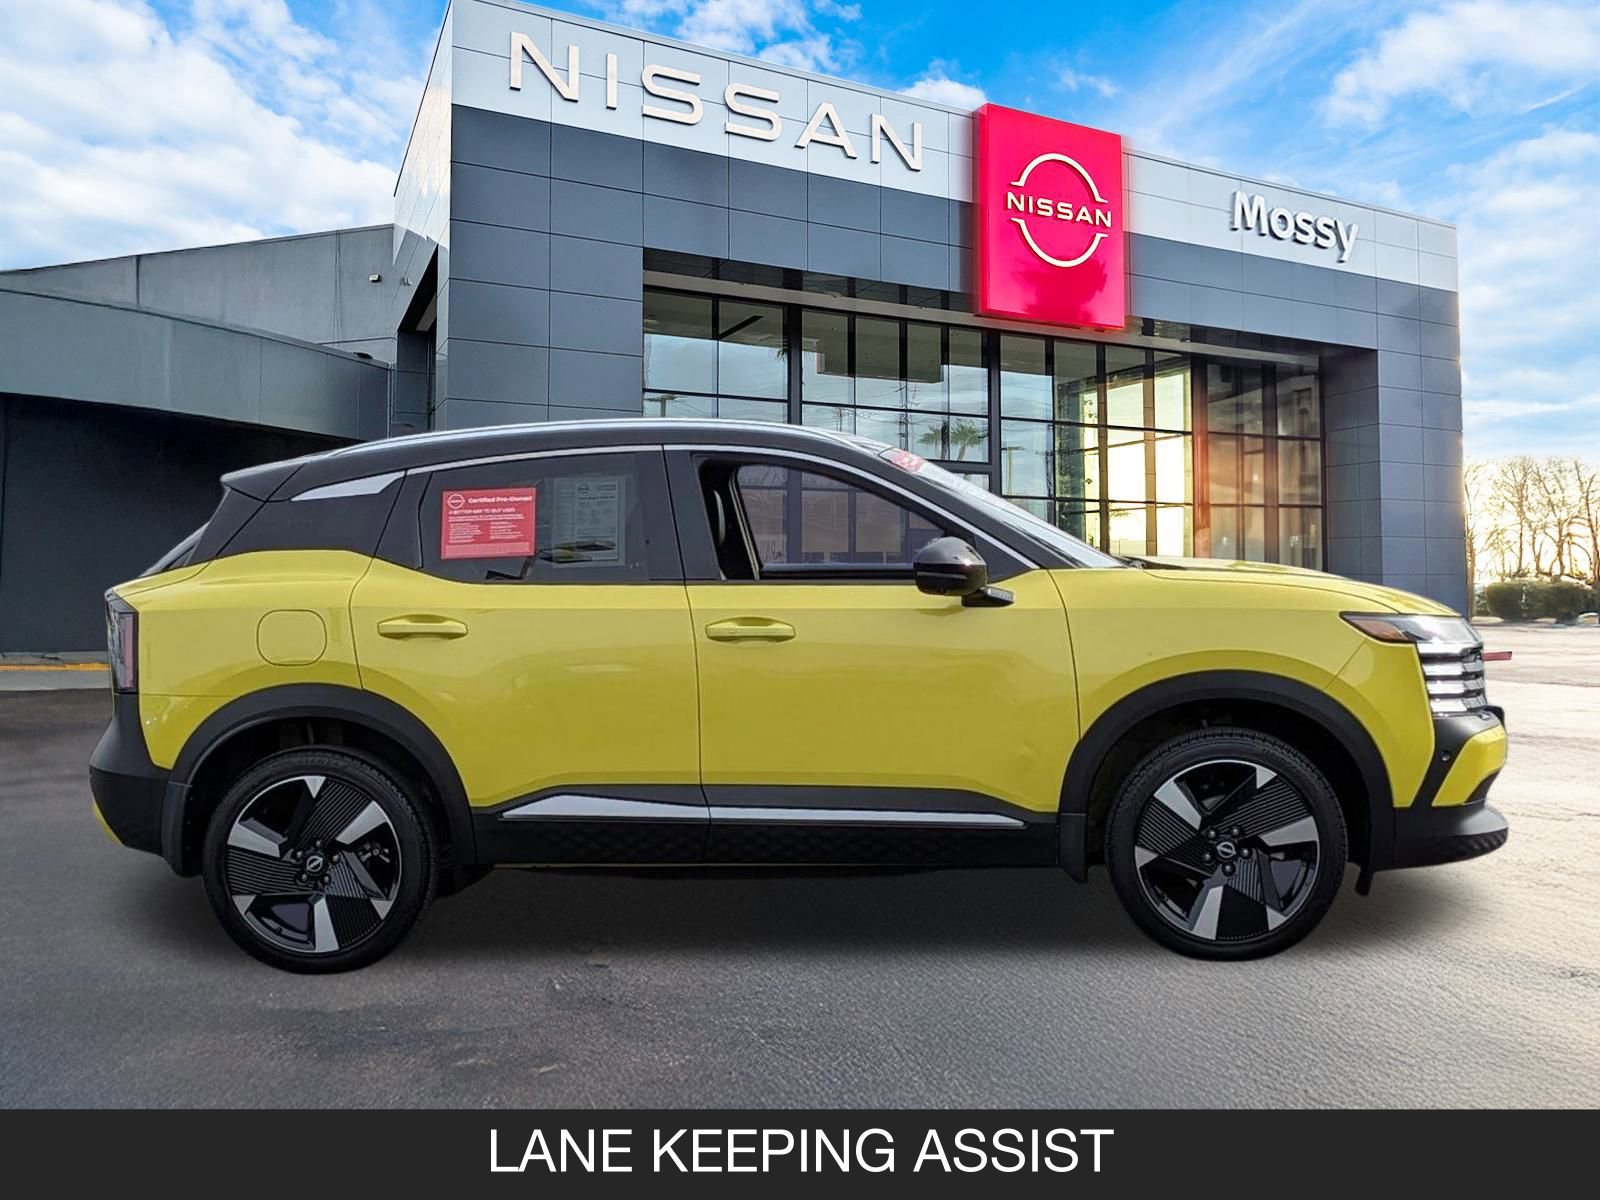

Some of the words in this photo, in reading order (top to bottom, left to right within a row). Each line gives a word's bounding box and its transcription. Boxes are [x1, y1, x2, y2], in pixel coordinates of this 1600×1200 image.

[509, 31, 922, 171] NISSAN
[1006, 191, 1112, 228] NISSAN
[1229, 189, 1360, 263] Mossy
